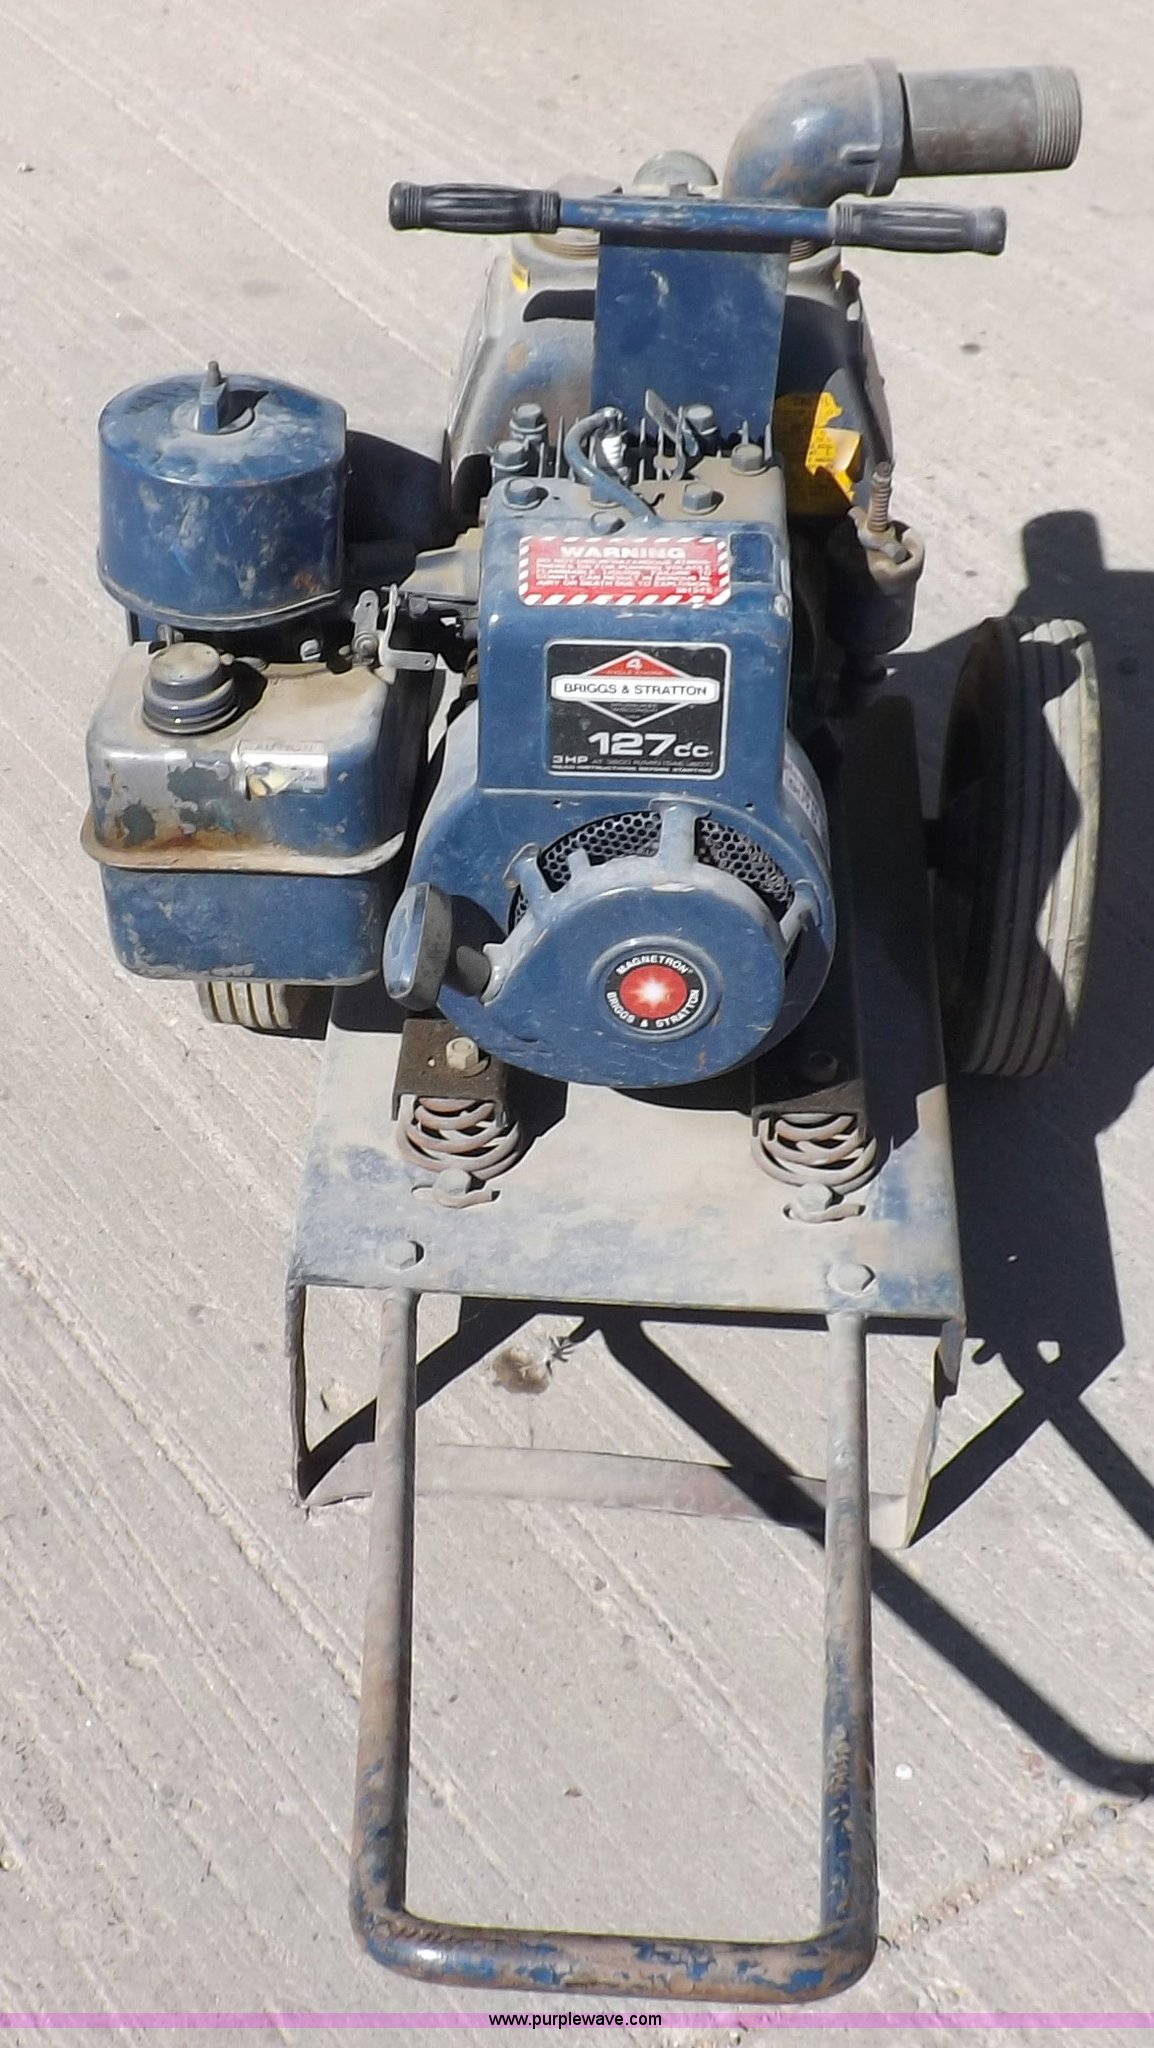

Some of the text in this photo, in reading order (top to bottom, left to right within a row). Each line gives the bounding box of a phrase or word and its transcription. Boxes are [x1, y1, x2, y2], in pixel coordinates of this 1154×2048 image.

[560, 546, 686, 559] WARNING
[625, 658, 643, 670] 4
[564, 683, 707, 695] BRIGGS & STRATTON
[607, 992, 635, 1024] BRIGGS
[655, 989, 700, 1028] STRATTON
